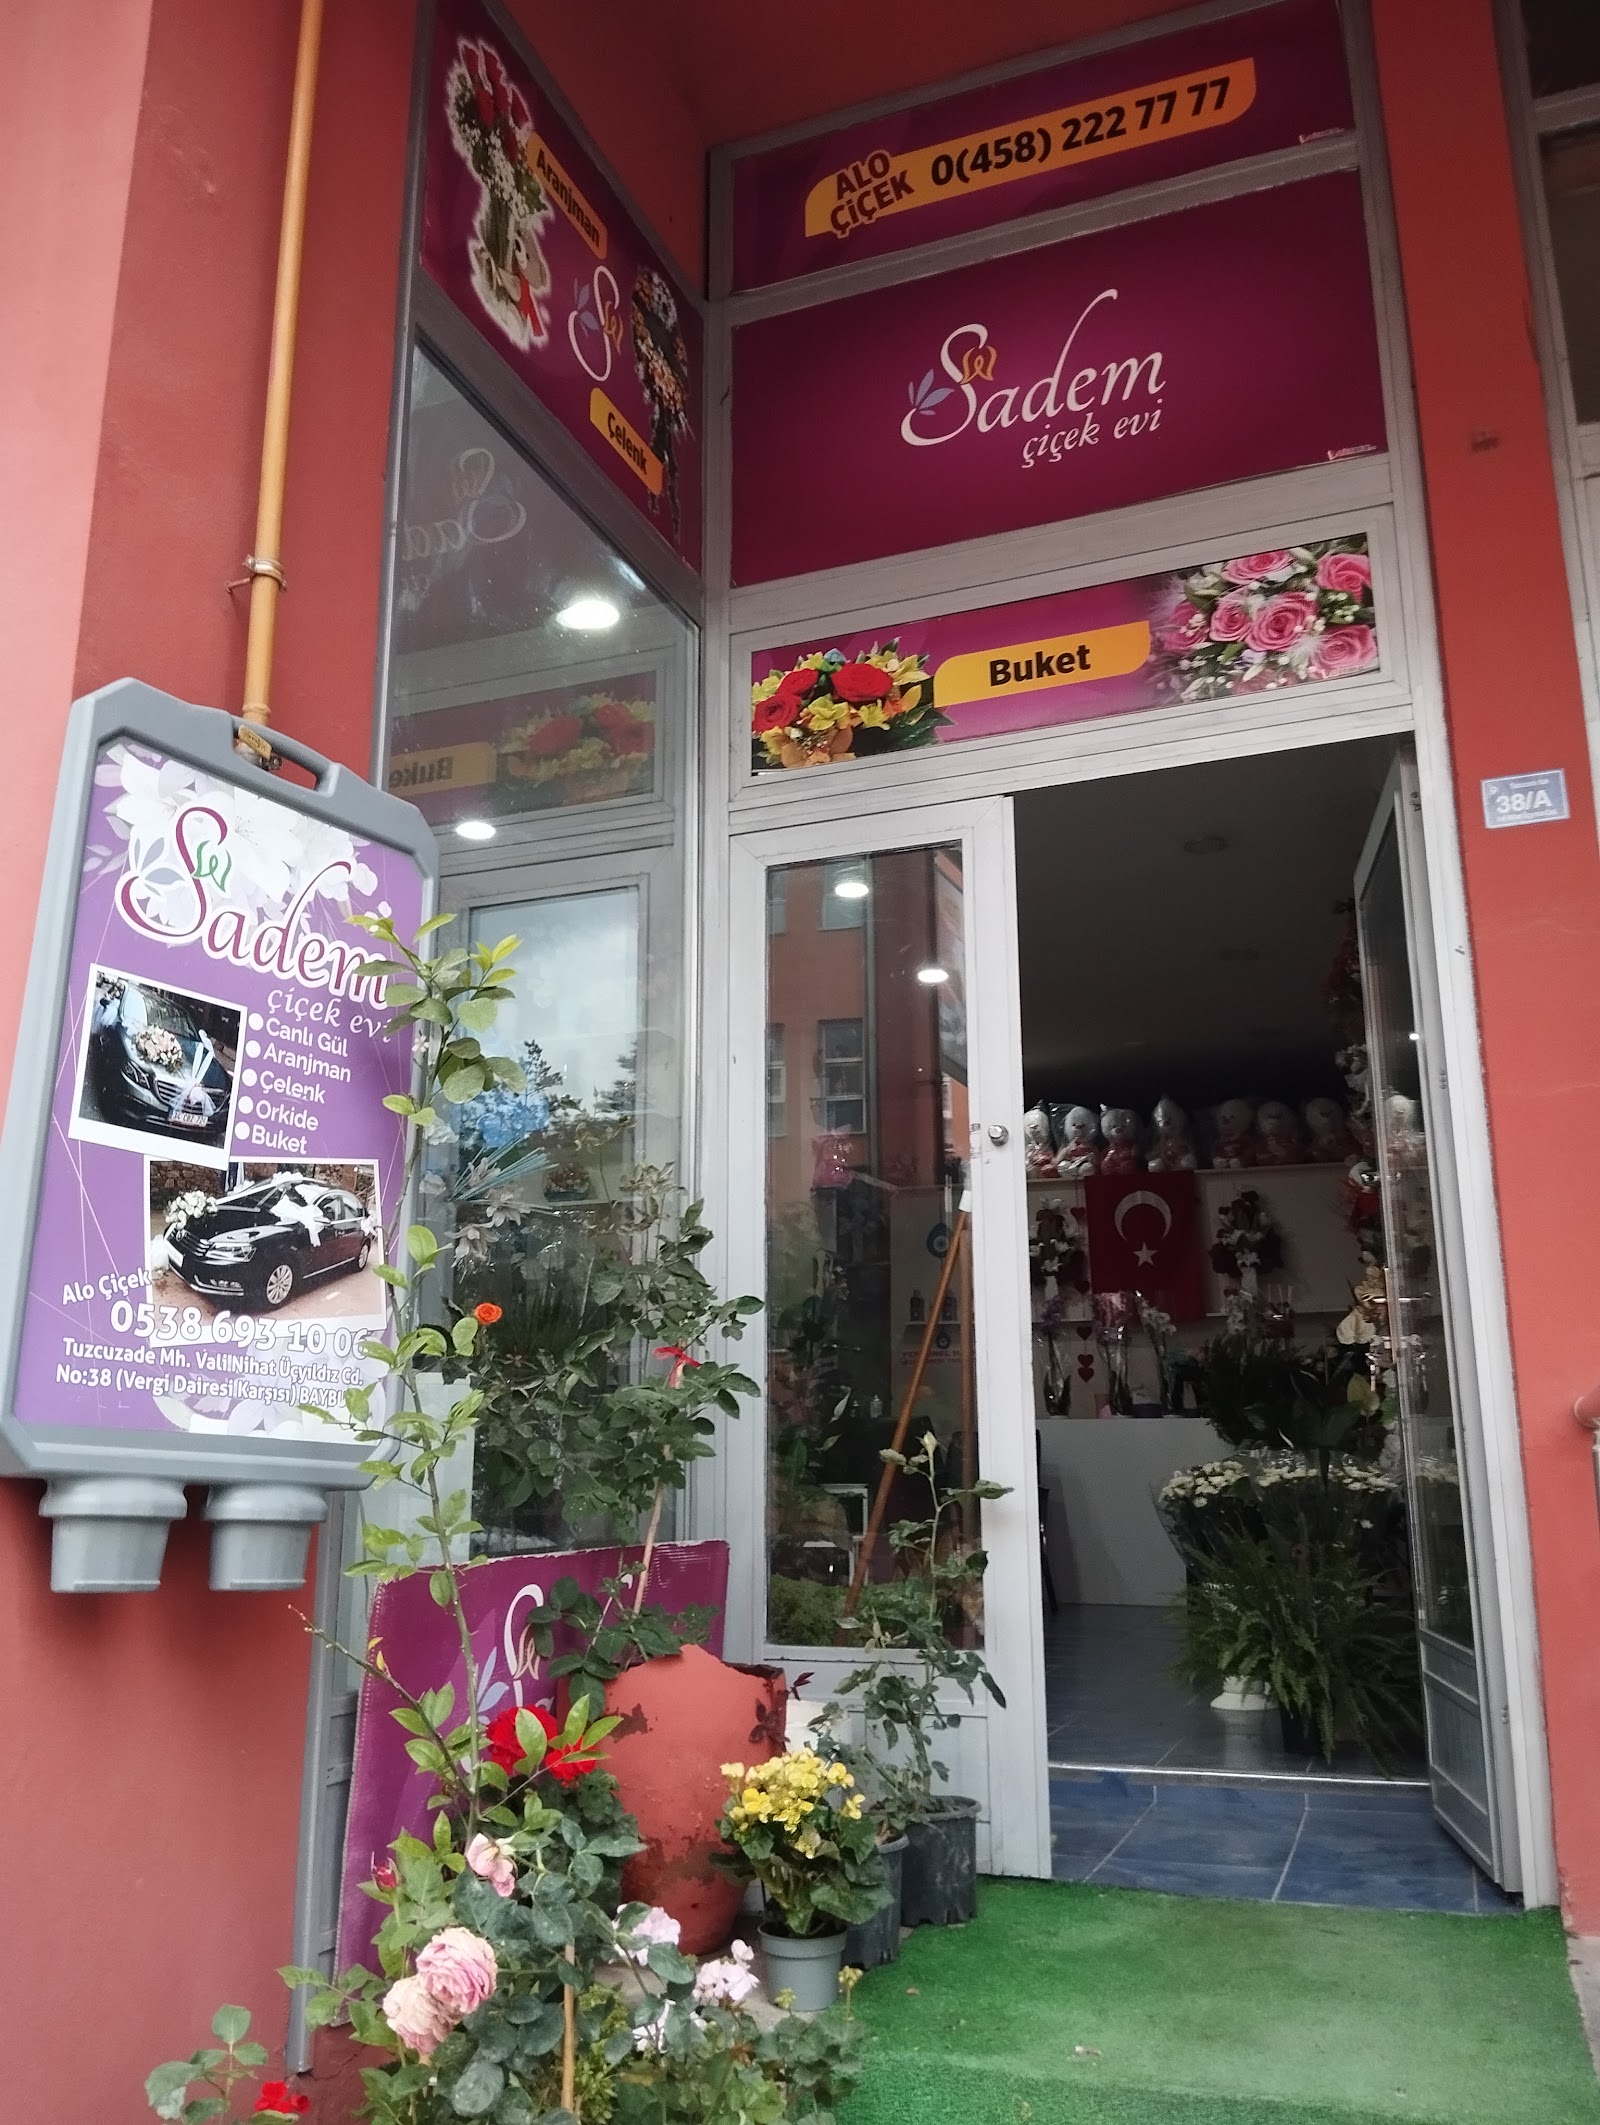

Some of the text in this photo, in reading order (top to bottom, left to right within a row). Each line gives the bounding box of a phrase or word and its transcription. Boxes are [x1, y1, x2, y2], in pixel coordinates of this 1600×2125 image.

[931, 76, 1231, 186] 0(458) 222 77 77
[536, 148, 600, 248] Aranjman
[836, 152, 891, 201] ALO
[901, 288, 1166, 446] Sadem
[606, 411, 648, 476] Çelenk
[1021, 398, 1163, 469] çiçek evi
[990, 644, 1091, 687] Buket
[1495, 789, 1553, 814] 38/A
[121, 806, 389, 1004] Sadem
[267, 987, 341, 1027] çiçek
[266, 1017, 349, 1058] Canlı Gül
[263, 1042, 351, 1083] Aranjman
[259, 1070, 326, 1104] Çelenk
[255, 1099, 319, 1131] Orkide
[251, 1124, 307, 1154] Buket
[62, 1267, 151, 1305] Alo Çiçek
[110, 1299, 368, 1361] 0538 693 10 06
[62, 1336, 156, 1365] Tuzcuzade
[159, 1347, 191, 1368] Mh.
[231, 1354, 277, 1377] Nihat
[278, 1356, 339, 1383] Üçyıldız
[341, 1366, 364, 1386] Cd.
[56, 1363, 348, 1409] No:38 (Vergi Dairesi Karşısı) BAYBU
